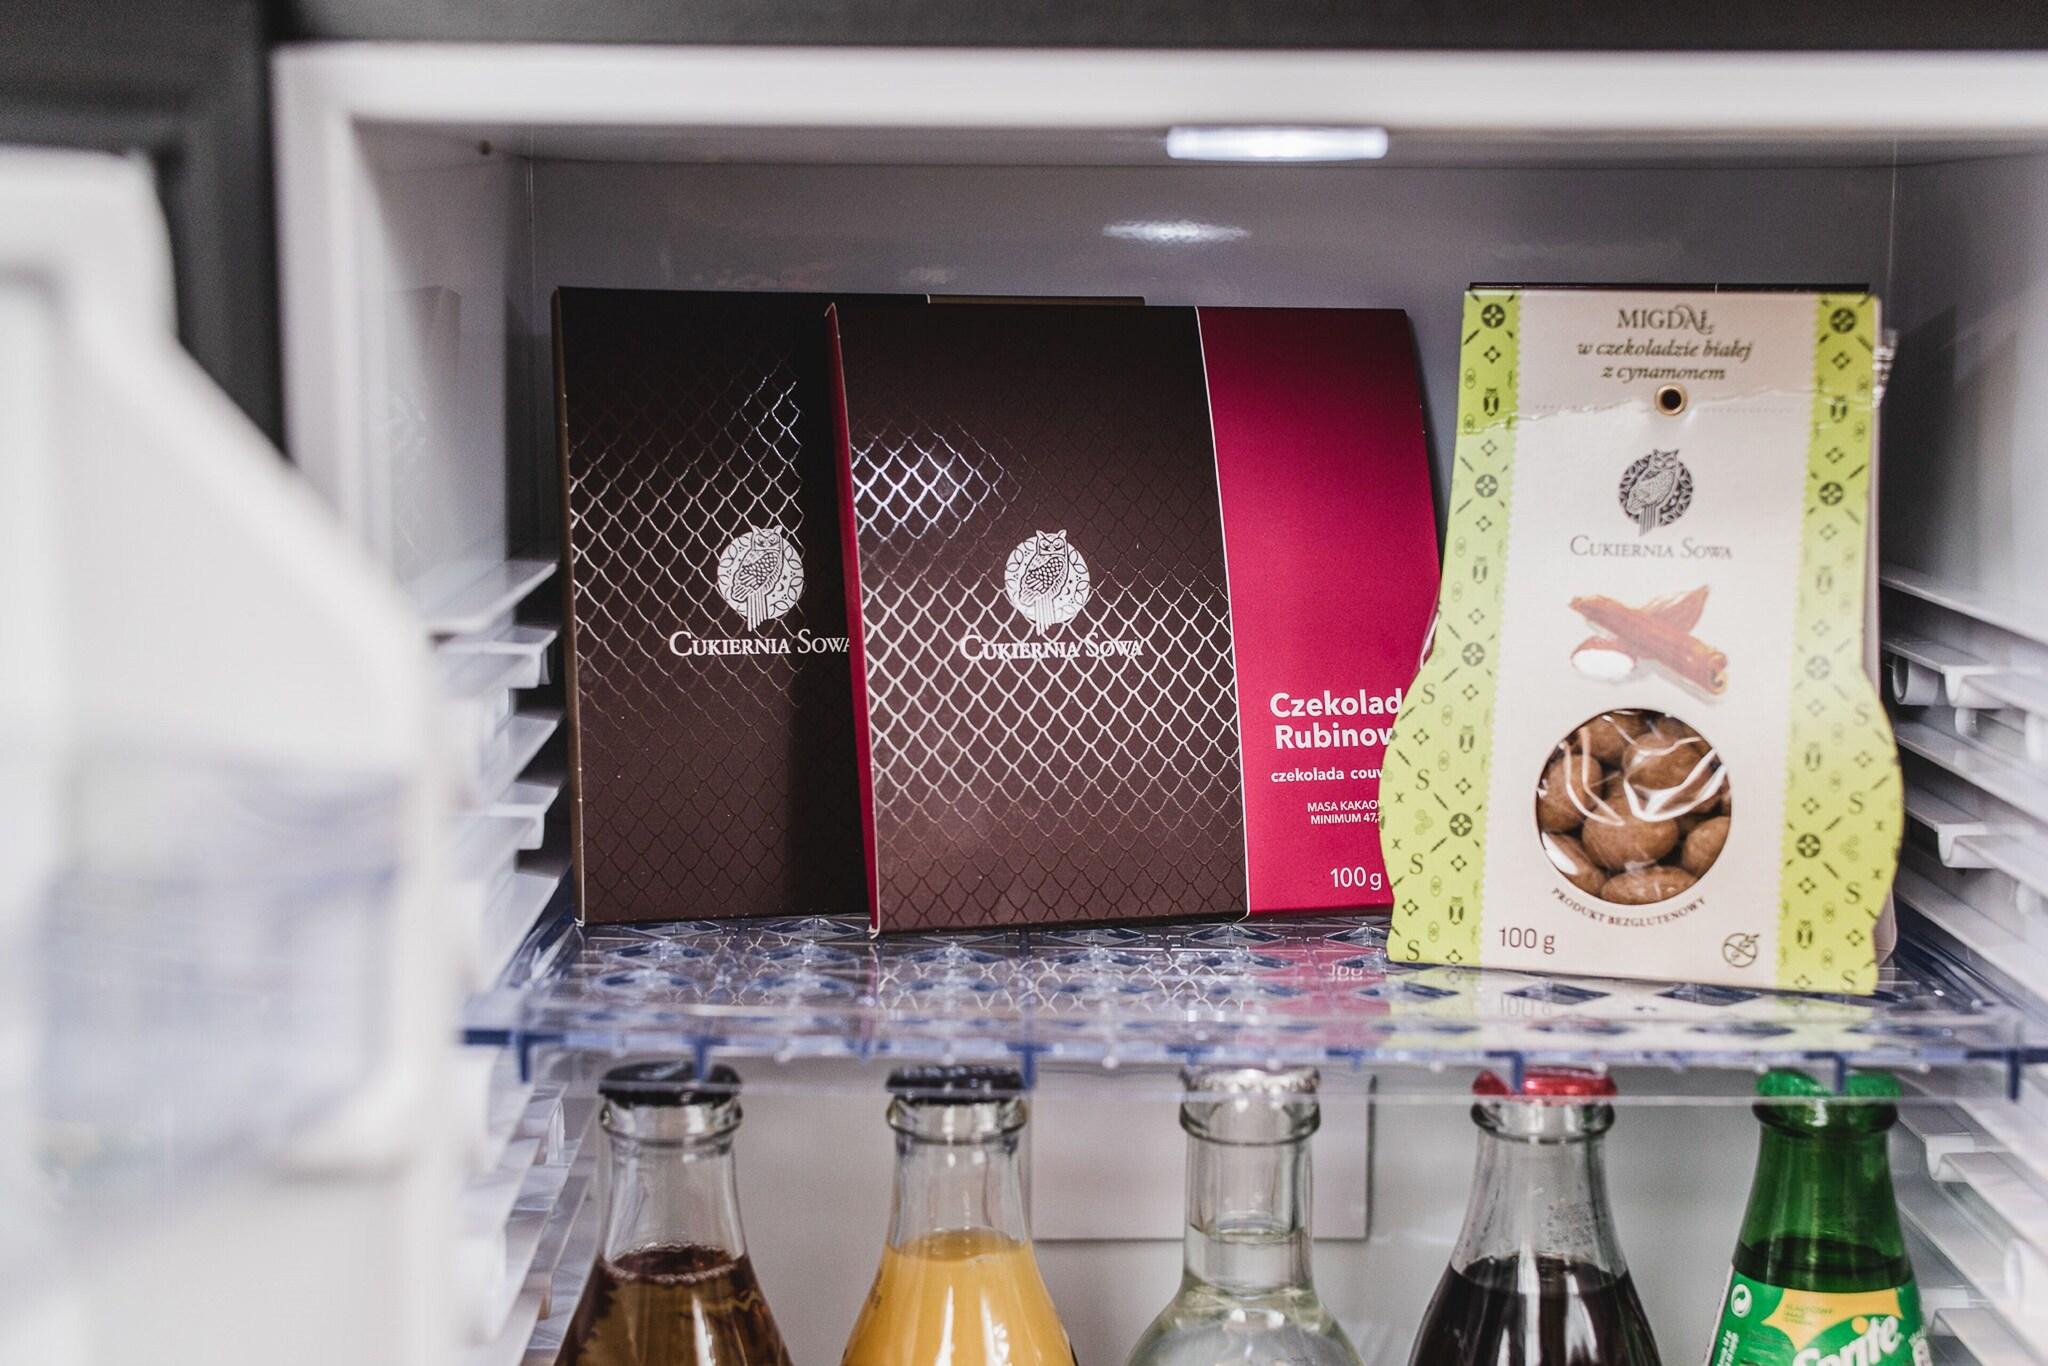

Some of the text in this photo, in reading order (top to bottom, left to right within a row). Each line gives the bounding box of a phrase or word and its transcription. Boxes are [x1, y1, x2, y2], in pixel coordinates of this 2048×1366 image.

[1577, 343, 1593, 356] w
[1596, 338, 1698, 358] czekoladzie
[1602, 364, 1725, 383] z cynamonem
[1570, 535, 1733, 560] CUKIERNIA SOWA
[669, 630, 791, 657] CUKIERNIA
[959, 631, 1144, 661] CUKIERNIA SOWA
[1270, 687, 1403, 718] Czekolad
[1271, 767, 1344, 782] czekolada
[1307, 800, 1380, 812] MASA KAKAO
[1310, 813, 1361, 825] MINIMUM
[1330, 867, 1382, 891] 100 g
[1551, 887, 1705, 927] PRODUKT BEZGLUTENOWY
[1499, 926, 1555, 954] 100 g
